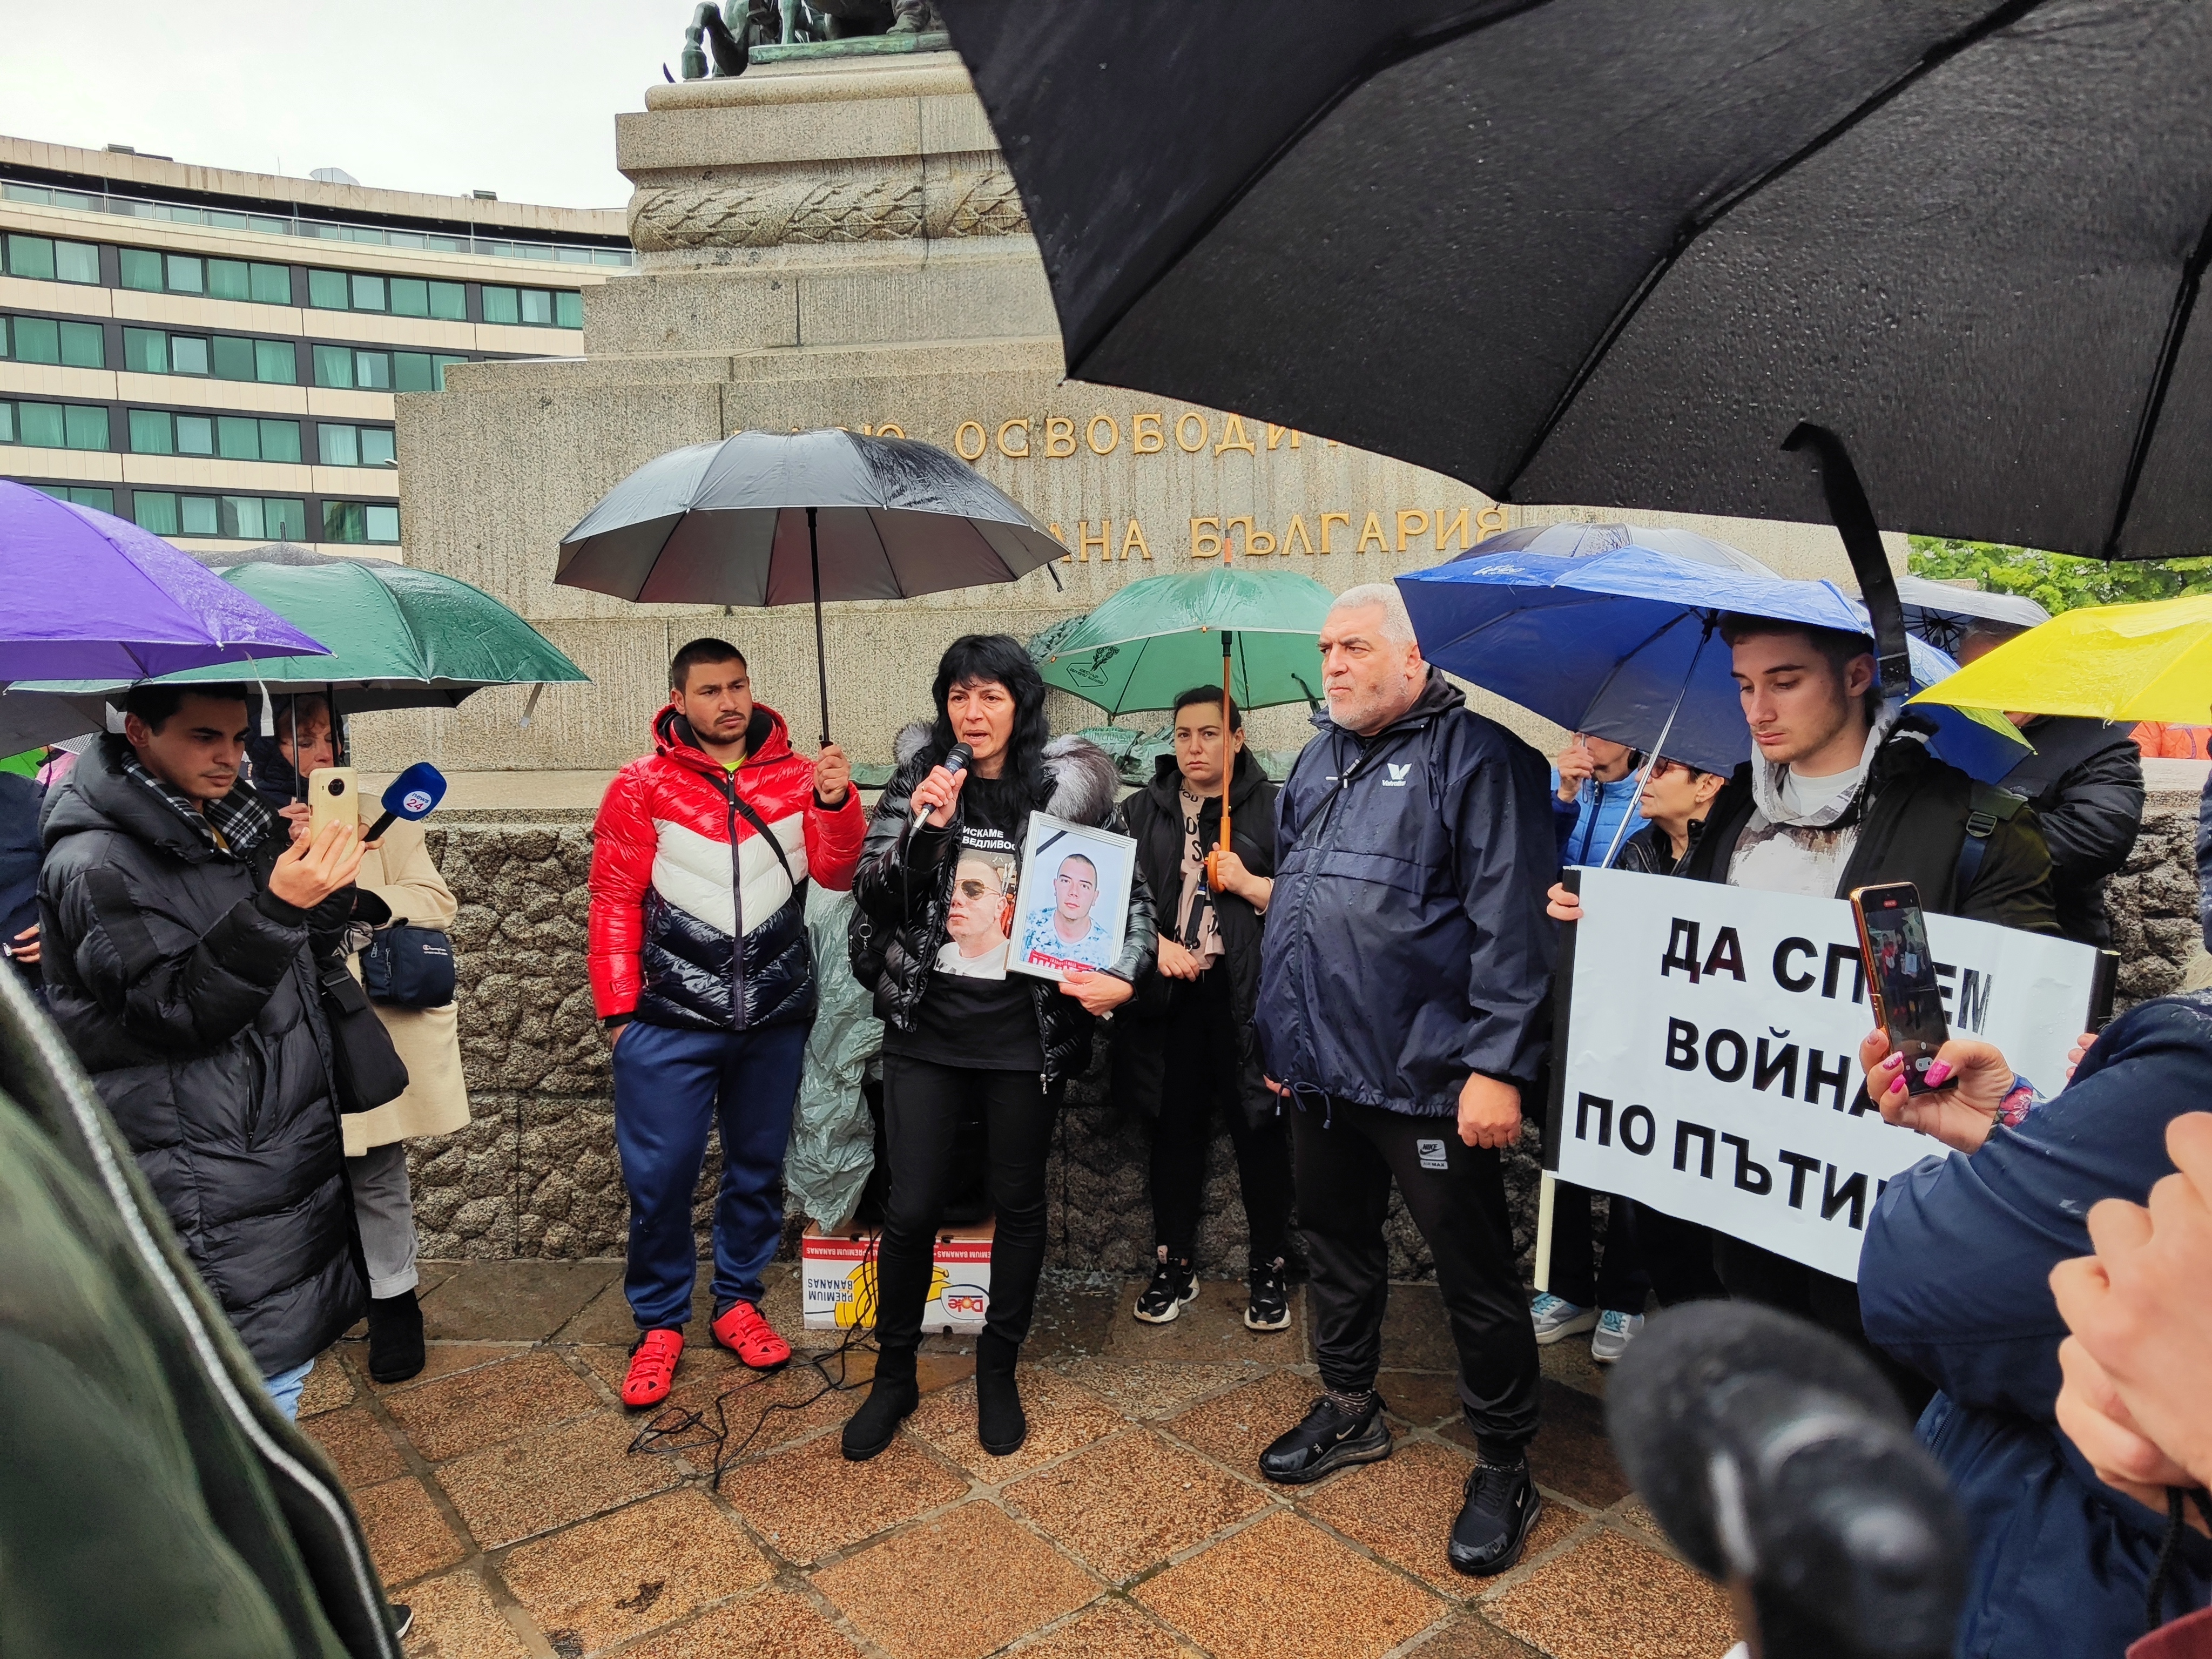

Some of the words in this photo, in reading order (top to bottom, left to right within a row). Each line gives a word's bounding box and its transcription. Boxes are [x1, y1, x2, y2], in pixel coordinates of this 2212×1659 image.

[955, 412, 1338, 460] ОСВОБОДИ
[1190, 505, 1509, 558] БЪЛГАРИЯ
[406, 798, 424, 811] 24
[412, 793, 430, 804] news
[962, 826, 1004, 838] ИСКАМЕ
[1661, 917, 1747, 984] ДА
[1772, 936, 1994, 1036] СПЕМ
[1575, 1091, 1656, 1156] ПО
[1673, 1119, 1889, 1232] ПЪТИ
[806, 1247, 836, 1256] BANANAS
[937, 1250, 968, 1258] BANANAS
[808, 1278, 853, 1290] BANANAS
[808, 1290, 853, 1302] PREMIUM
[948, 1297, 983, 1313] Dole
